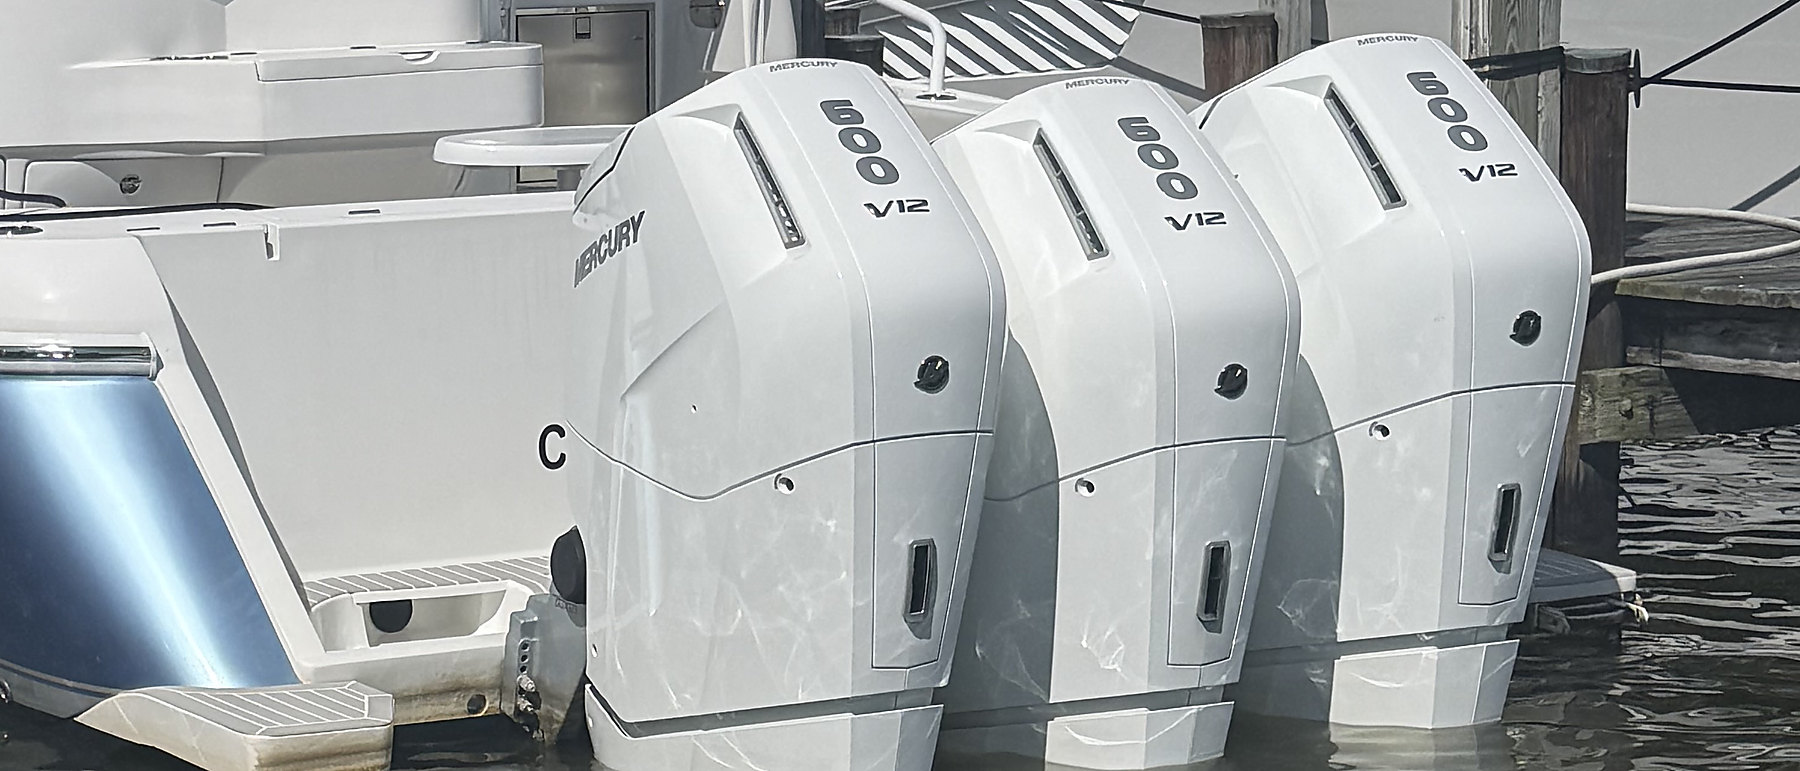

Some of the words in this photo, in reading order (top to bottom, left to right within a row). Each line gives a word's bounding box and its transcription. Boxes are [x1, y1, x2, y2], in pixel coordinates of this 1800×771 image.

[1357, 35, 1419, 46] MERCURY
[769, 60, 838, 73] MERCURY
[1065, 78, 1131, 90] MERCURY
[1407, 71, 1489, 152] 600
[820, 99, 900, 185] 600
[1117, 116, 1199, 200] 600
[1458, 163, 1519, 183] V12
[863, 199, 931, 219] V12
[1164, 211, 1228, 231] V12
[538, 424, 566, 470] C
